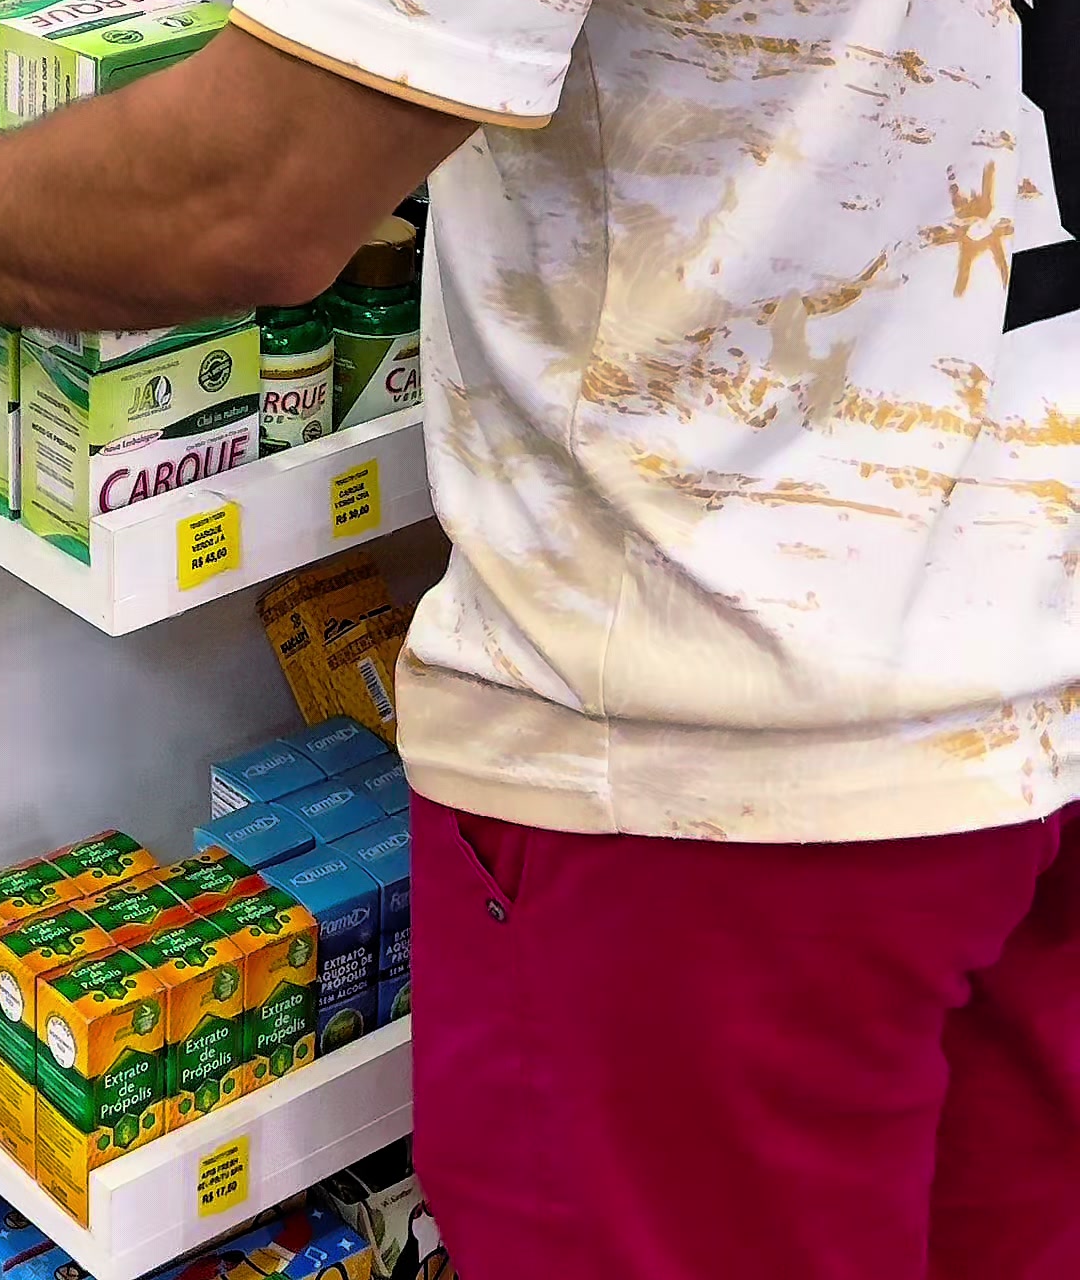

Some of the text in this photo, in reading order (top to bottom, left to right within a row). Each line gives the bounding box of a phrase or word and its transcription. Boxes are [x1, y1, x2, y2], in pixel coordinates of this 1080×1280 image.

[100, 431, 250, 514] CARQUE
[317, 953, 373, 984] AQUOSO DE
[324, 947, 365, 971] EXTRATO
[321, 967, 367, 994] PRÓPOLIS
[262, 994, 303, 1020] Extrato
[275, 1013, 290, 1028] de
[186, 1026, 229, 1055] Extrato
[257, 1018, 306, 1048] Própolis
[182, 1052, 232, 1084] Própolis
[200, 1048, 216, 1062] de
[104, 1061, 149, 1089] Extrato
[119, 1082, 135, 1097] de
[101, 1088, 152, 1120] Própolis
